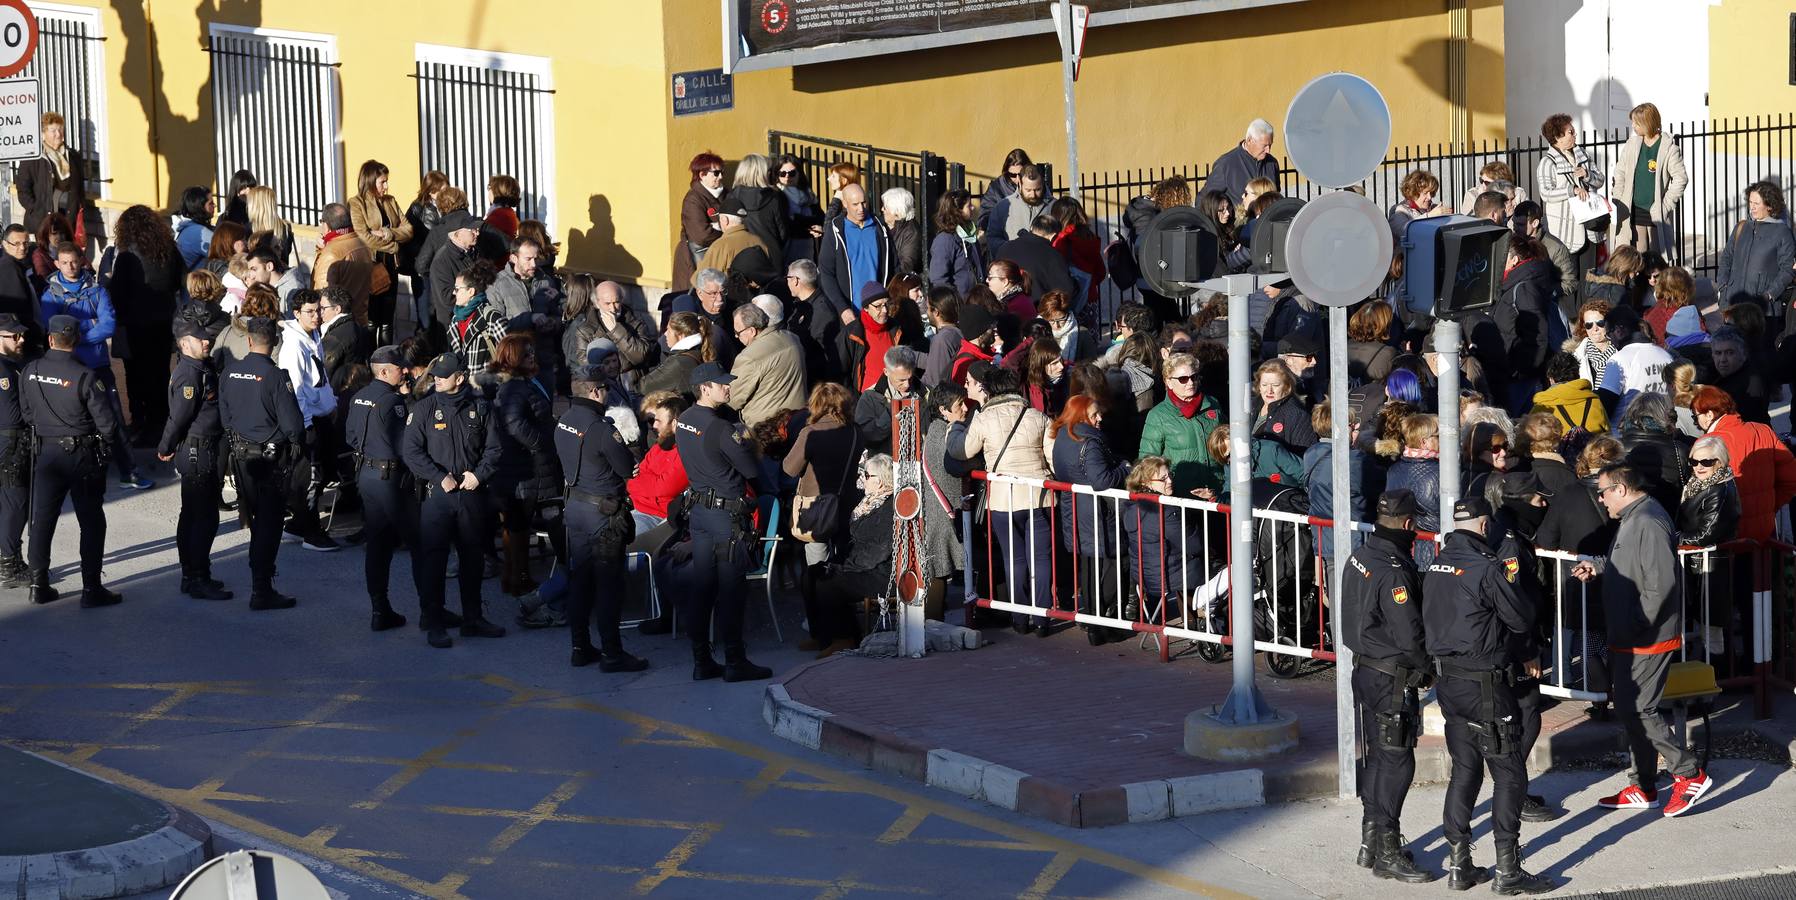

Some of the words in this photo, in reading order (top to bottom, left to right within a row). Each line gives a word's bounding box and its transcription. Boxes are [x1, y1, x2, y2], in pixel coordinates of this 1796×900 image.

[770, 9, 780, 23] 5
[796, 22, 808, 31] Total
[692, 74, 727, 88] CALLE
[29, 374, 63, 385] POLICIA
[558, 422, 578, 435] POLICIA
[677, 422, 697, 433] POLICIA
[1350, 556, 1367, 575] POLICIA
[1428, 564, 1455, 573] POLICIA
